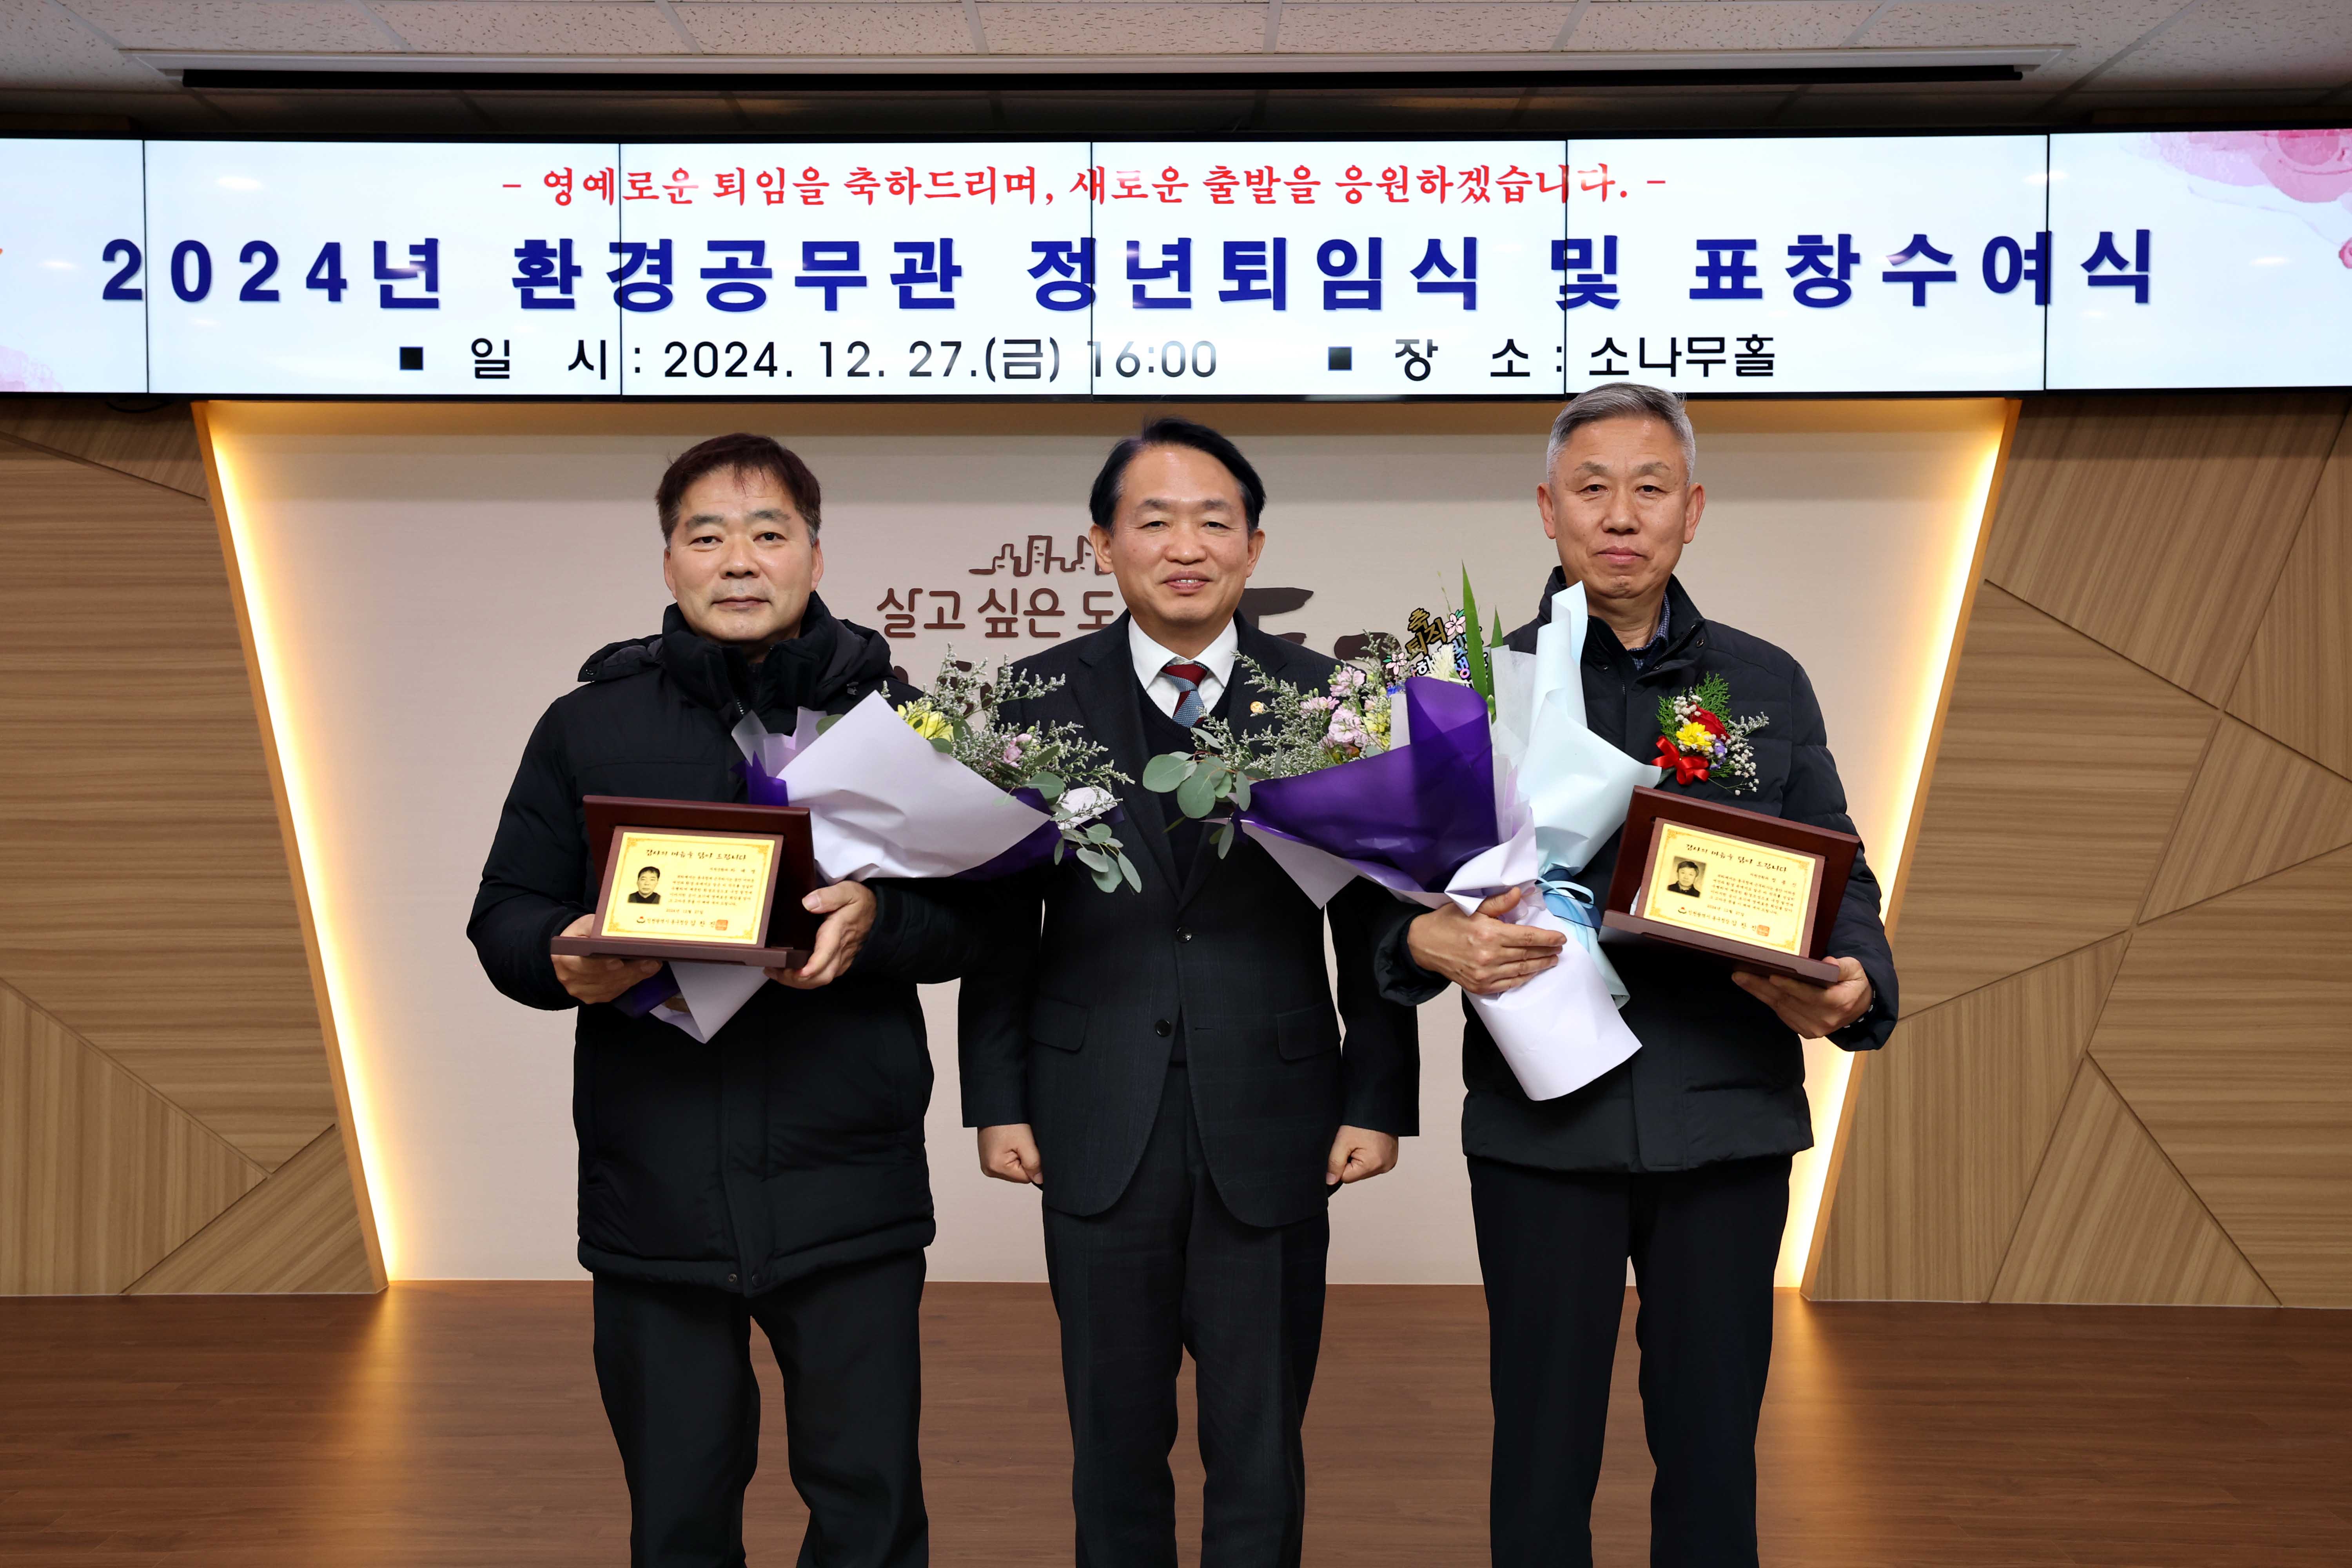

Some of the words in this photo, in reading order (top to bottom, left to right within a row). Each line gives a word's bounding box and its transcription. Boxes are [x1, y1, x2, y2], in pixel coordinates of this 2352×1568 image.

[544, 167, 700, 206] 영예로운
[713, 167, 830, 205] 퇴임을
[844, 166, 1053, 205] 축하드리며,
[1070, 165, 1189, 204] 새로운
[1203, 165, 1321, 205] 출발을
[1336, 163, 1628, 204] 응원하겠습니다.
[102, 238, 439, 309] 2024년
[512, 238, 962, 312] 환경공무관
[1027, 237, 1477, 311] 정년퇴임식
[1551, 235, 1621, 311] 및
[1689, 229, 2151, 309] 표창수여식
[664, 341, 792, 378] 2024.
[819, 341, 884, 377] 12.
[909, 337, 1059, 382] 27.(금)
[1087, 340, 1217, 378] 16:00
[1589, 334, 1775, 378] 소나무홀
[877, 588, 965, 638] 살고
[978, 588, 1065, 638] 싶은
